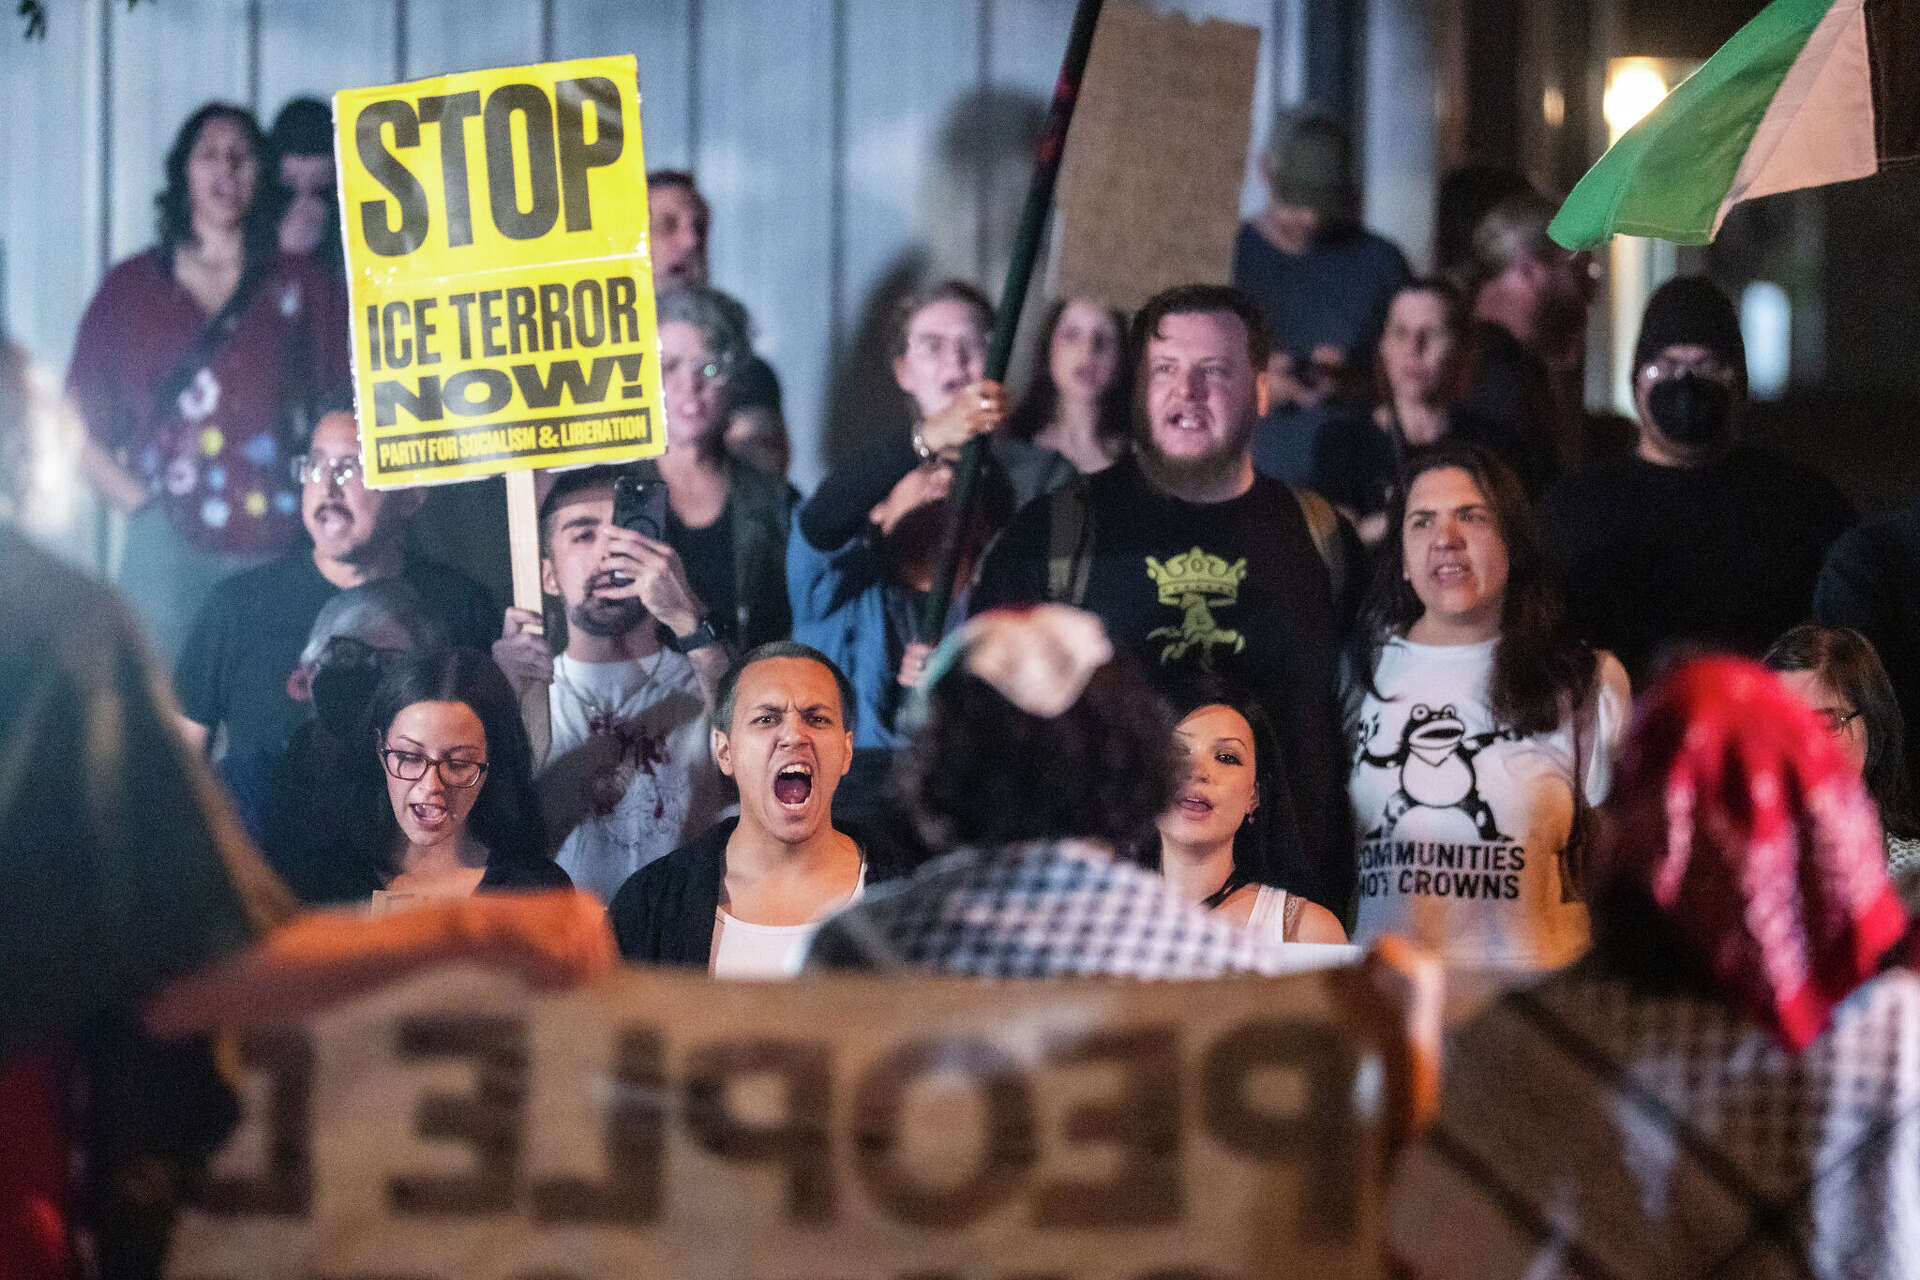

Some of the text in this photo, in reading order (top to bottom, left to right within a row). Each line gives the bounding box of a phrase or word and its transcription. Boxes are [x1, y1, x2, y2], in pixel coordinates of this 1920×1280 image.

[355, 76, 624, 257] STOP
[367, 276, 640, 371] ICE TERROR
[373, 352, 643, 427] NOW!
[380, 415, 647, 468] PARTY FOR SOCIALISM & LIBERATION
[1358, 841, 1525, 871] OMMUNITIES
[1400, 869, 1519, 899] CROWNS
